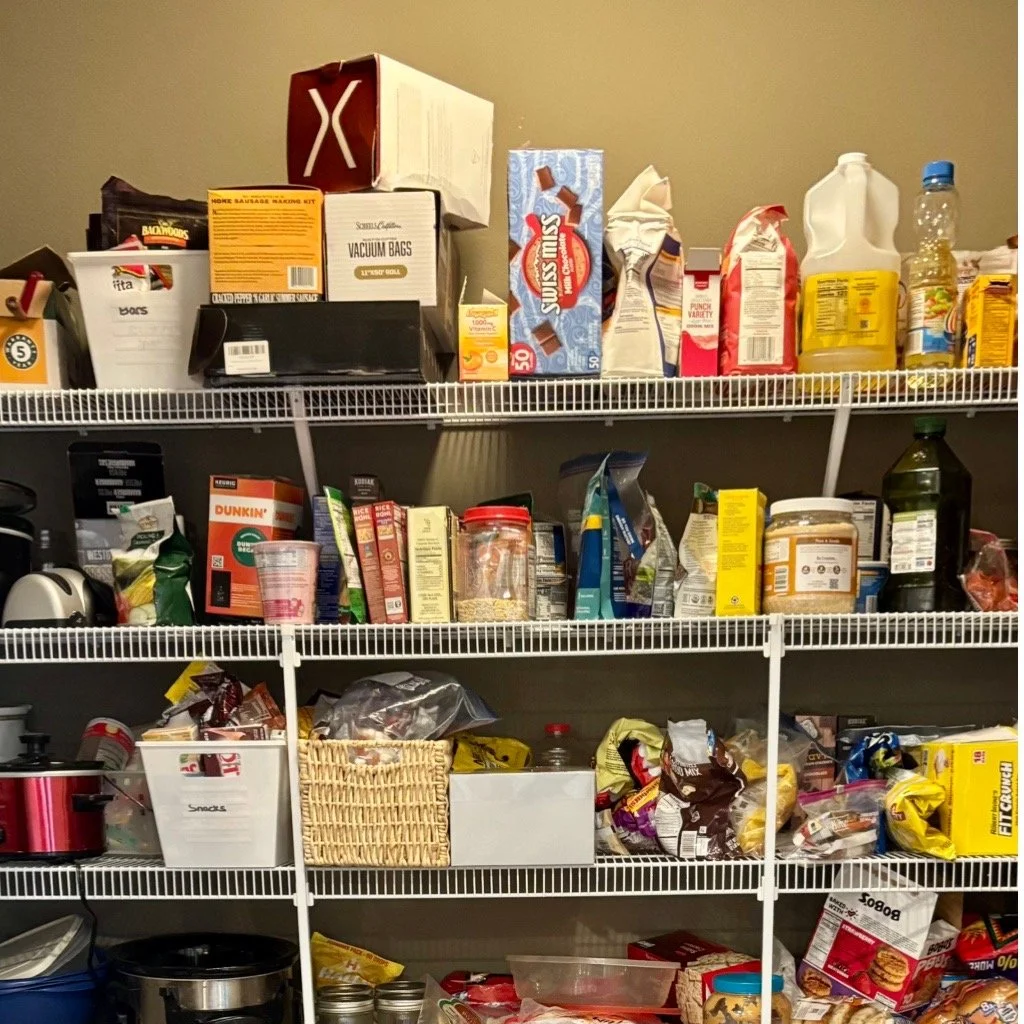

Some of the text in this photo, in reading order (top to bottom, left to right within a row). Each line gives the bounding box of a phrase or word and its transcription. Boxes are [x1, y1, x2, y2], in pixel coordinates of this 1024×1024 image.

[141, 225, 190, 241] BACKWOODS
[348, 241, 412, 258] VACUUM BAGS
[559, 232, 571, 275] Chocolate
[690, 303, 711, 311] PUNCH
[688, 310, 714, 319] VARIETY
[16, 345, 26, 358] 5
[515, 349, 531, 371] 50
[588, 356, 600, 369] 50
[214, 479, 236, 487] KEURIG
[354, 478, 375, 486] KODIAK
[214, 505, 268, 519] DUNKIN'
[353, 507, 369, 515] RICE
[188, 803, 227, 813] Snacks
[828, 904, 844, 916] WITH
[829, 896, 847, 911] BAKED
